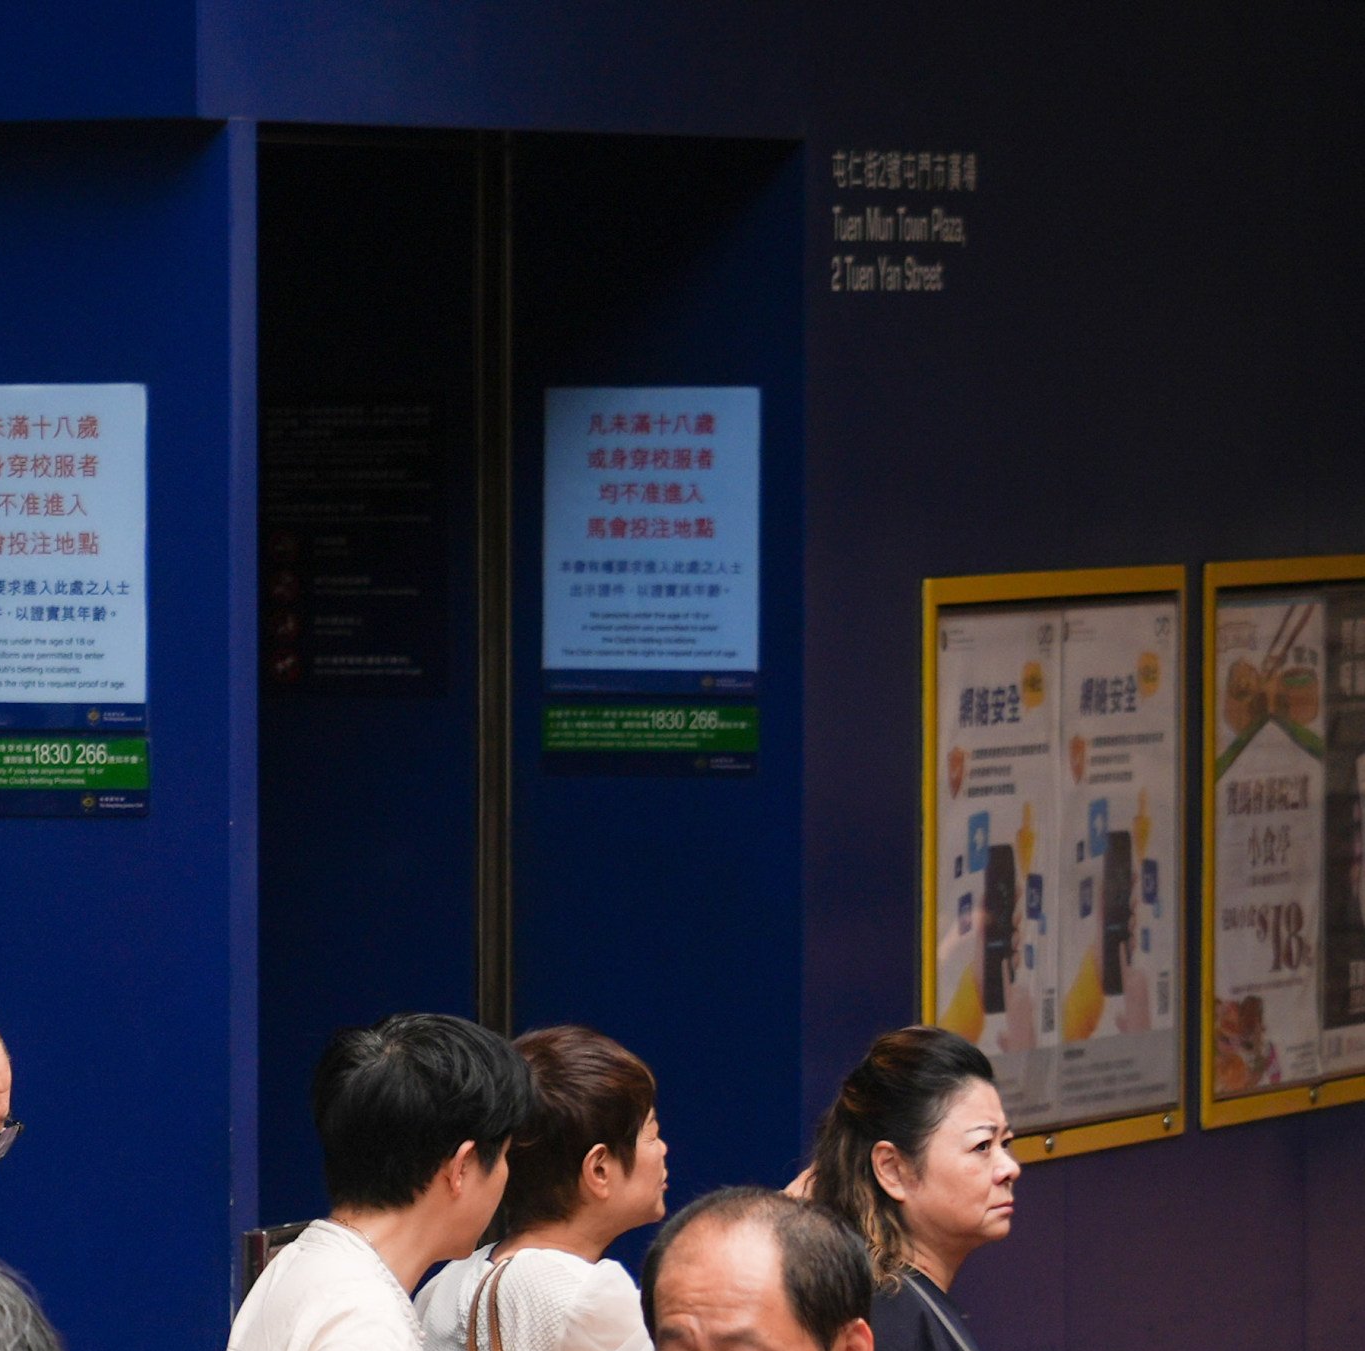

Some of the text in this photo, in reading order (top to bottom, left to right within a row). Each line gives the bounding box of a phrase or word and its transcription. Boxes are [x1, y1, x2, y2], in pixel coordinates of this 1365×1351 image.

[832, 206, 864, 241] Tuen
[866, 206, 894, 241] Mun
[896, 206, 928, 241] Town
[831, 255, 944, 291] 2 Tuen Yan Street
[587, 413, 716, 437] 凡未滿十八歲
[9, 637, 32, 647] under
[34, 637, 46, 647] the
[959, 684, 1021, 728] 網絡安全
[649, 710, 685, 730] 1830
[689, 710, 719, 730] 266
[33, 743, 72, 765] 1830
[75, 743, 108, 765] 266
